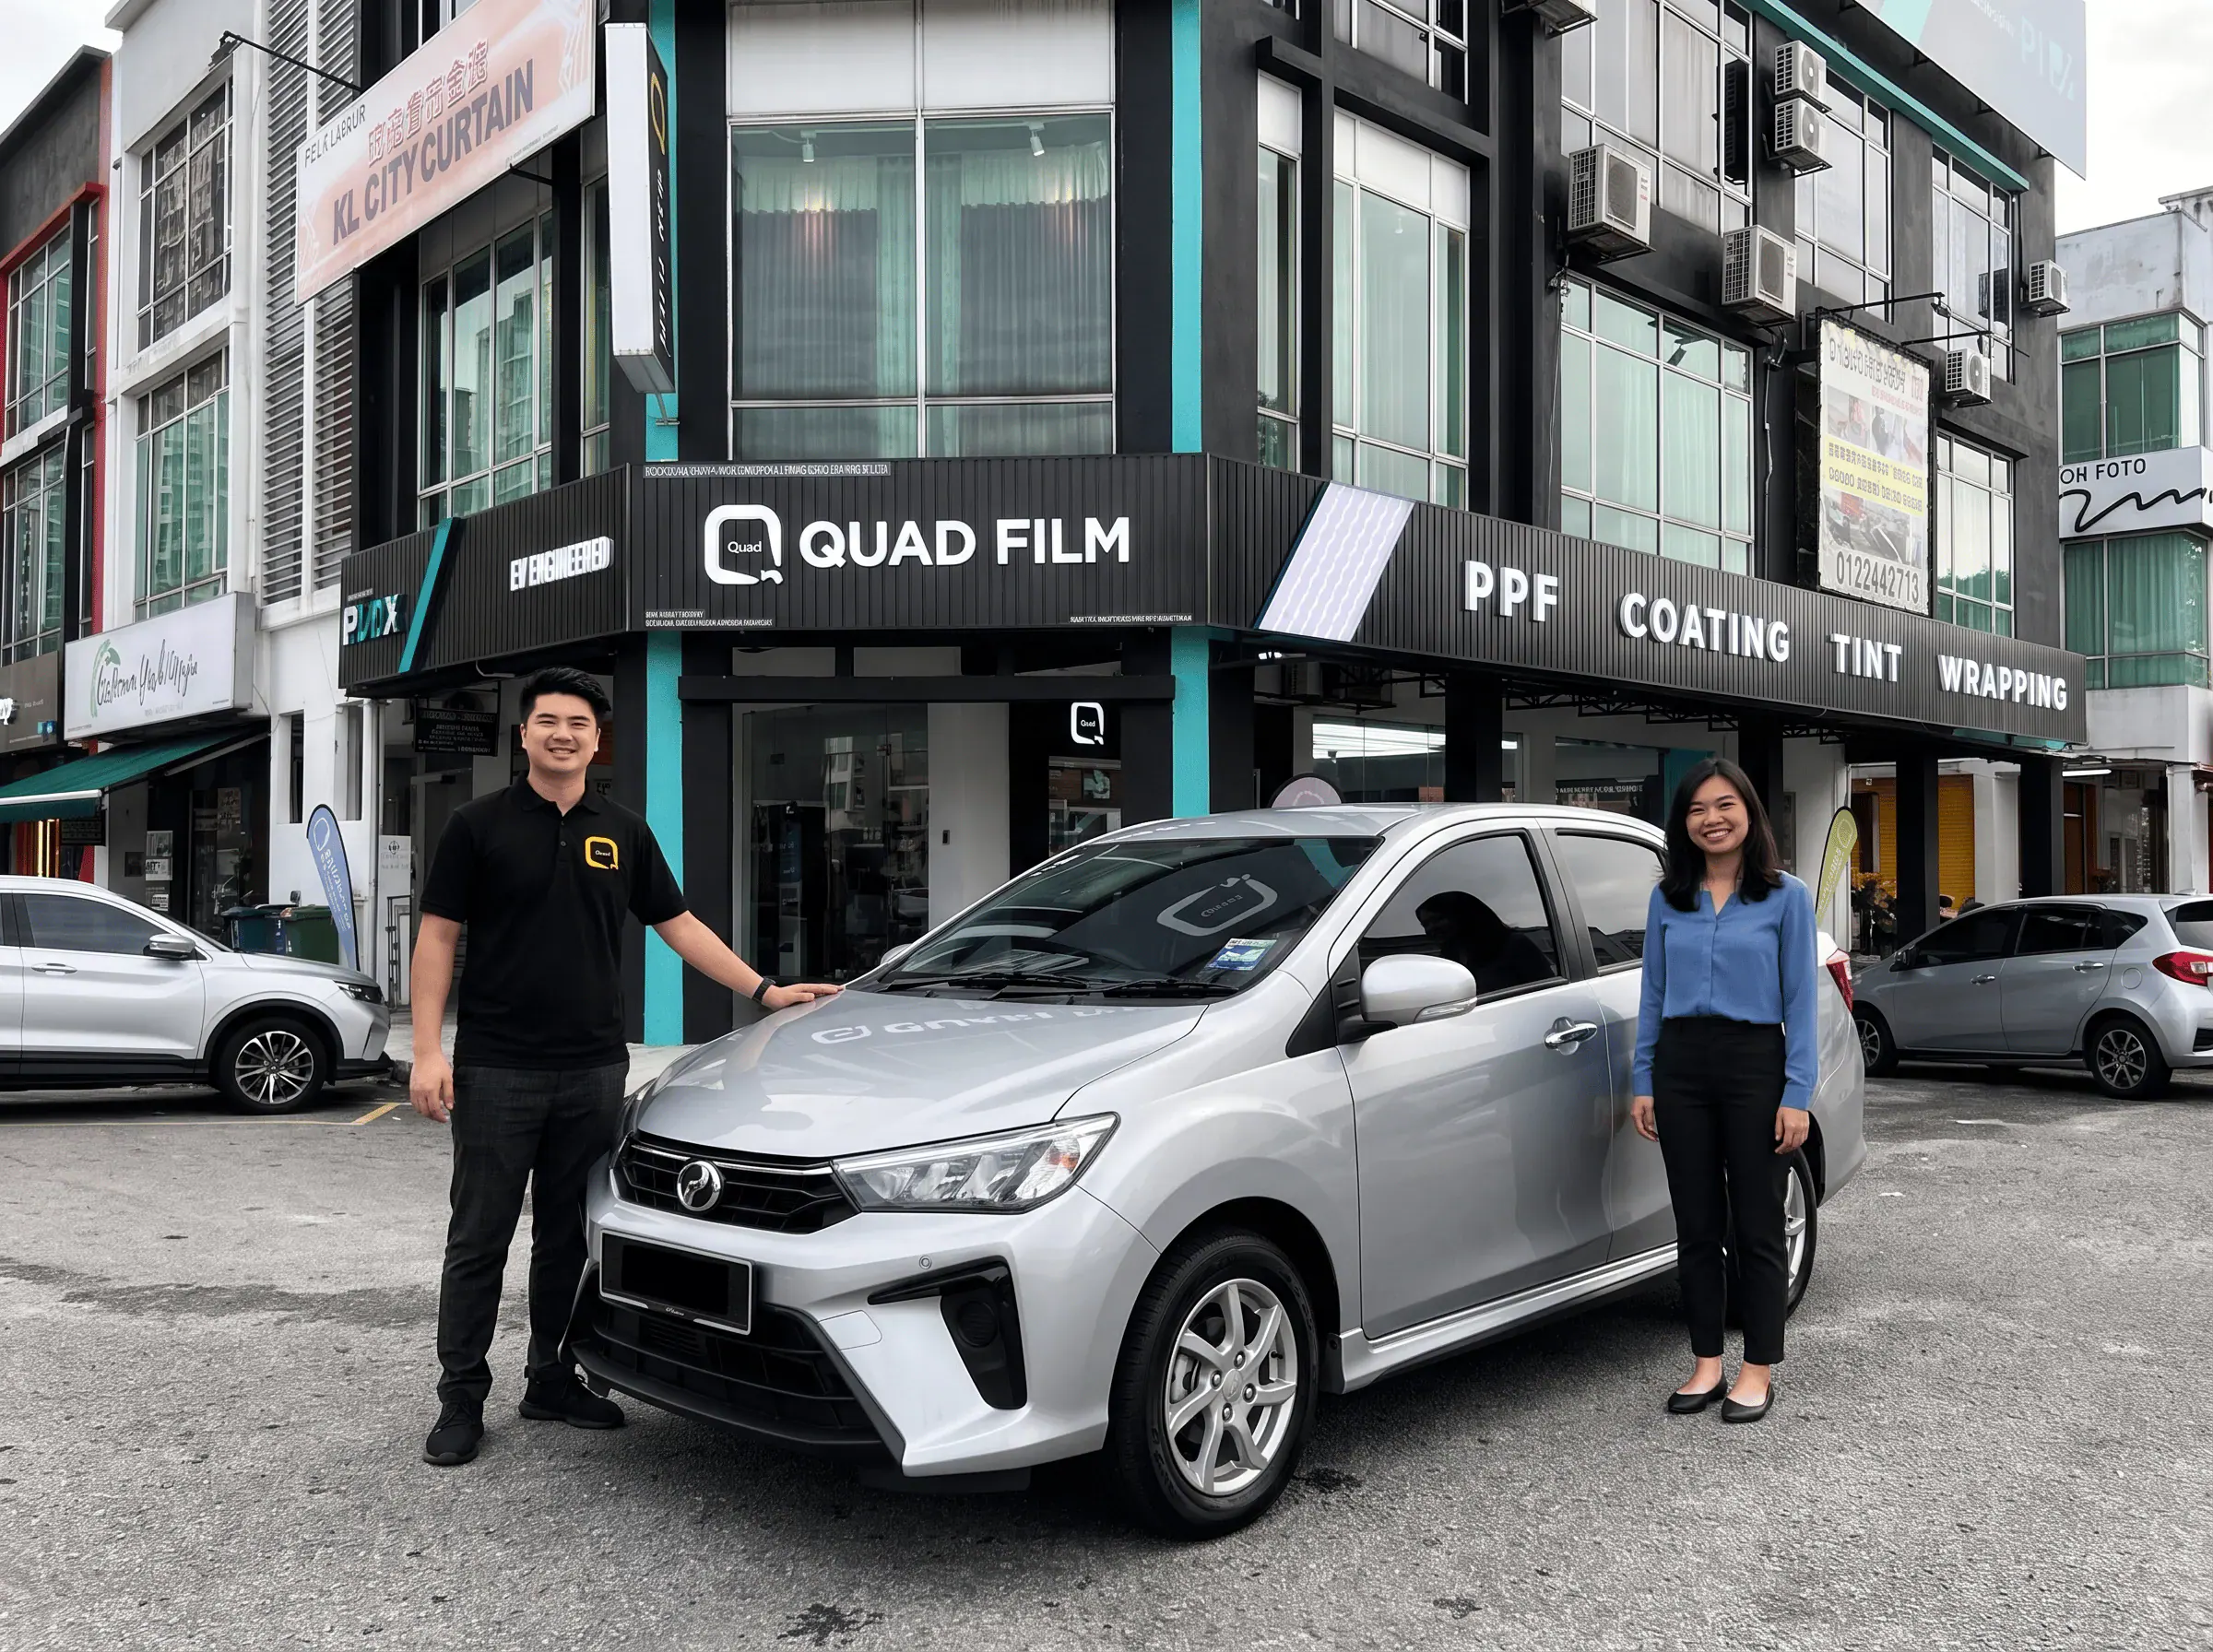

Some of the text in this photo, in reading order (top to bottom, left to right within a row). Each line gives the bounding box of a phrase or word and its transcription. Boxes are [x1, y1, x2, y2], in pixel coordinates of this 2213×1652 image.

[333, 188, 361, 246] KL
[364, 143, 419, 222] CITY
[420, 58, 534, 183] CURTAIN
[2096, 458, 2147, 480] FOTO
[728, 540, 763, 554] Quad
[799, 516, 1130, 569] QUAD FILM
[1837, 550, 1919, 604] 0122442713
[1463, 560, 2067, 711] PPF COATING TINT WRAPPING
